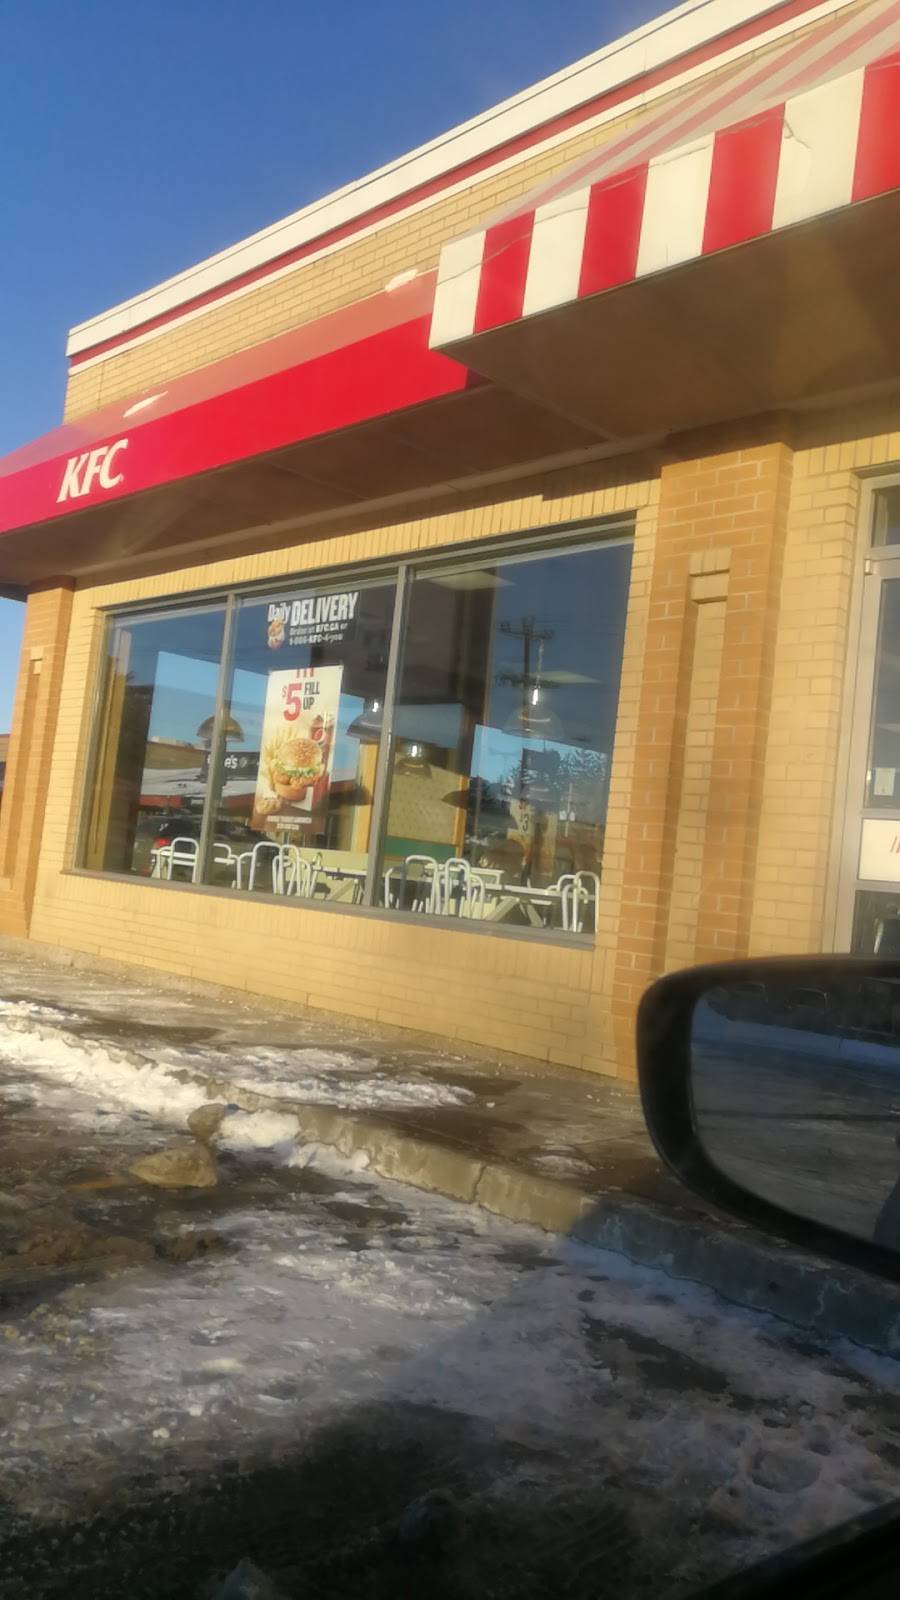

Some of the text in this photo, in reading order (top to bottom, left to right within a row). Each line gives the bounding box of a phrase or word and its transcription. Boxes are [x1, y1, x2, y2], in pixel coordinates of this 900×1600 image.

[56, 438, 128, 503] KFC
[290, 592, 359, 626] DELIVERY
[282, 683, 302, 721] $5
[303, 697, 315, 710] UP
[304, 682, 320, 696] FILL
